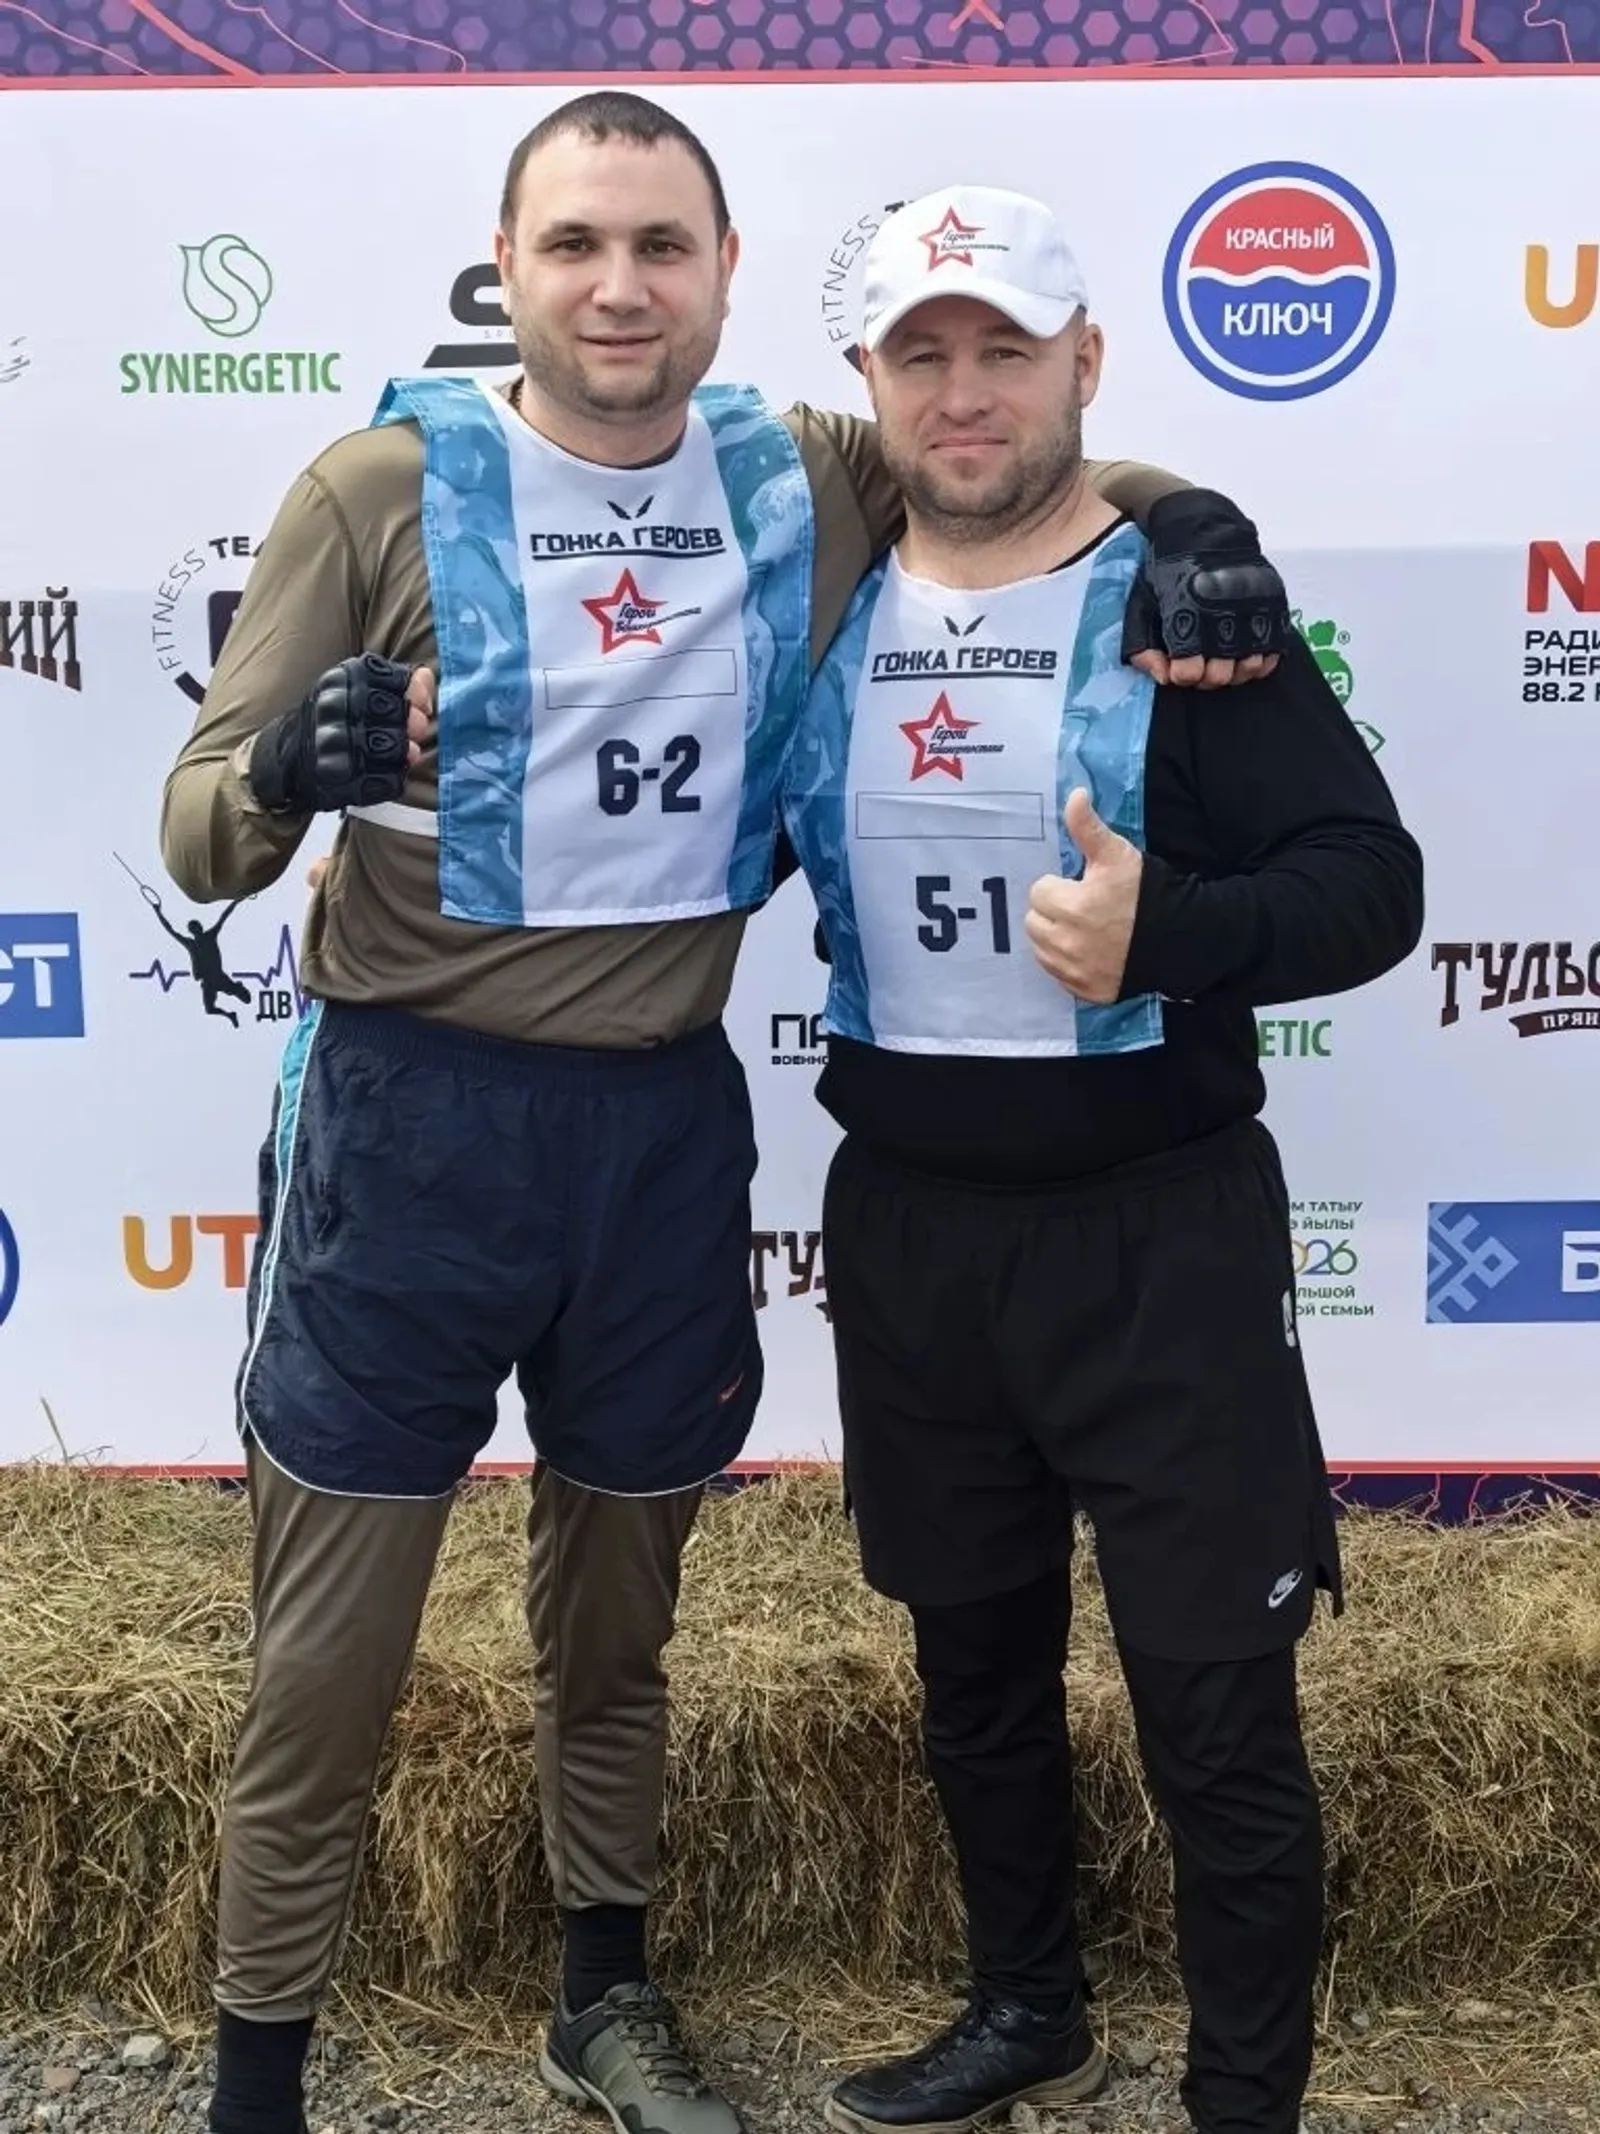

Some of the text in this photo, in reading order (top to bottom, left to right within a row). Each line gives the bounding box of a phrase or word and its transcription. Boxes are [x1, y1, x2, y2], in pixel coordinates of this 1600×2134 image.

[1226, 222, 1335, 250] КРАСНЫЙ
[821, 214, 880, 343] FITNESS
[1223, 302, 1333, 336] КЛЮЧ
[120, 352, 341, 393] SYNERGETIC
[530, 525, 723, 553] ГОНКА ГЕРОЕВ
[152, 548, 206, 672] FITNESS
[872, 646, 1057, 674] ГОНКА ГЕРОЕВ
[1522, 682, 1585, 702] 88.2
[597, 734, 702, 817] 6-2
[916, 876, 1011, 955] 5-1
[1258, 1020, 1332, 1057] ETIC
[1303, 1216, 1355, 1230] ЙЫЛЫ
[1308, 1201, 1363, 1212] ТАТЫУ
[751, 1231, 824, 1311] ТУ
[1320, 1305, 1375, 1316] СЕМЬИ
